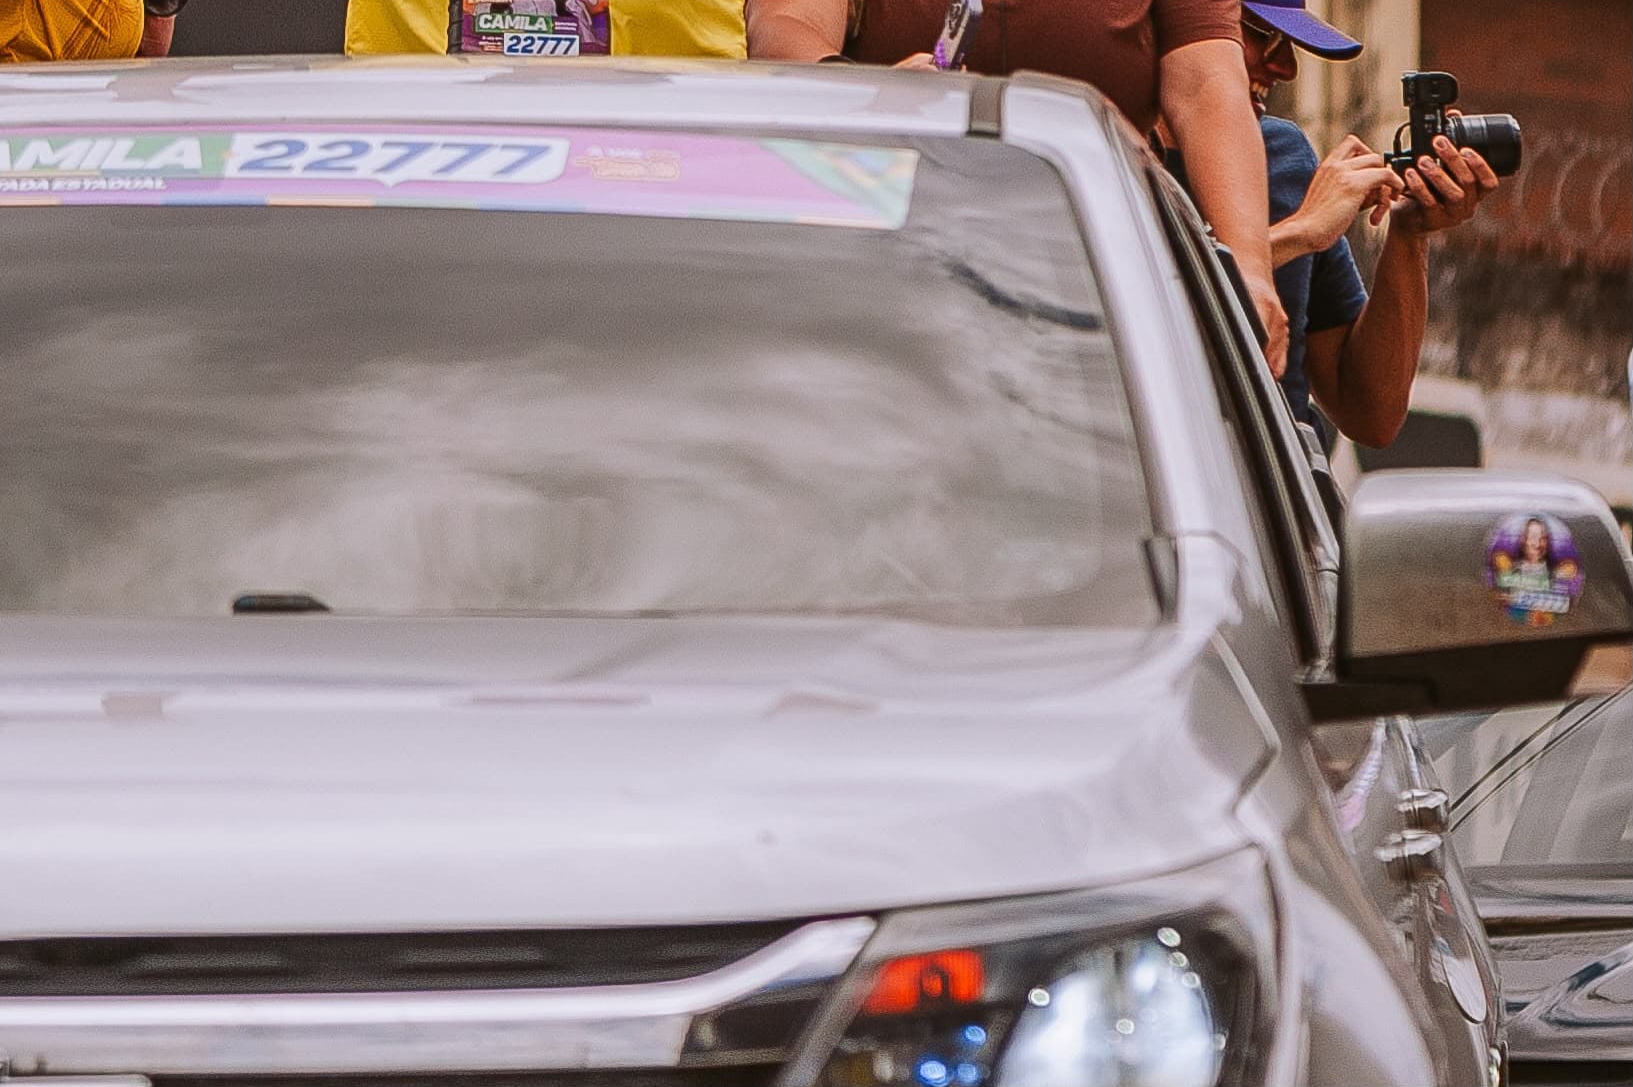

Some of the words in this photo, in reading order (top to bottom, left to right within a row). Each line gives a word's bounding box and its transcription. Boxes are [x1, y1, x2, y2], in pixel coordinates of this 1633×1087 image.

[479, 14, 548, 31] CAMILA
[506, 35, 576, 55] 22777
[237, 138, 552, 178] 22777
[52, 176, 167, 191] ESTADUAL
